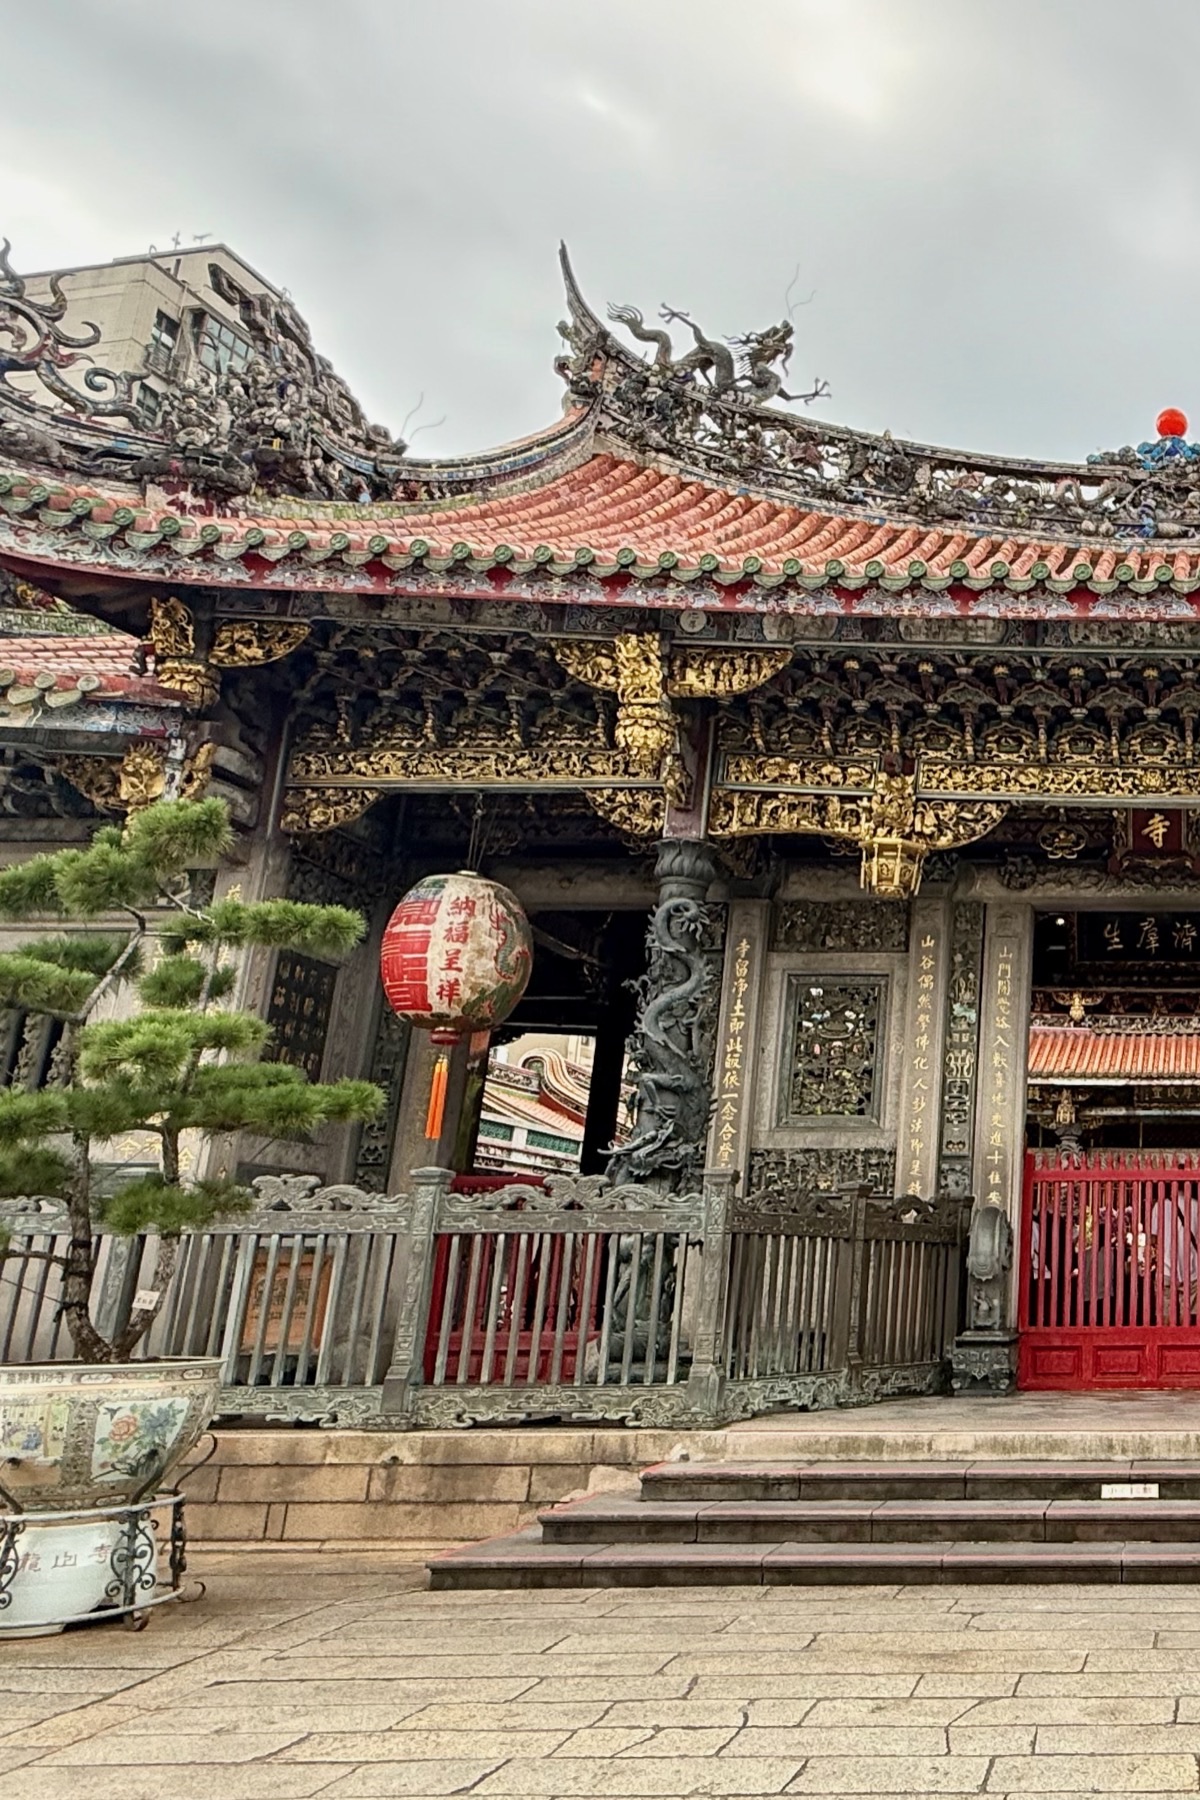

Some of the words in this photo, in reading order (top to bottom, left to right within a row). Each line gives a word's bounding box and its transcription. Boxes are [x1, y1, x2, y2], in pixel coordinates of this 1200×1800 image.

[1141, 813, 1171, 848] 寺
[437, 896, 477, 1007] 納福呈祥
